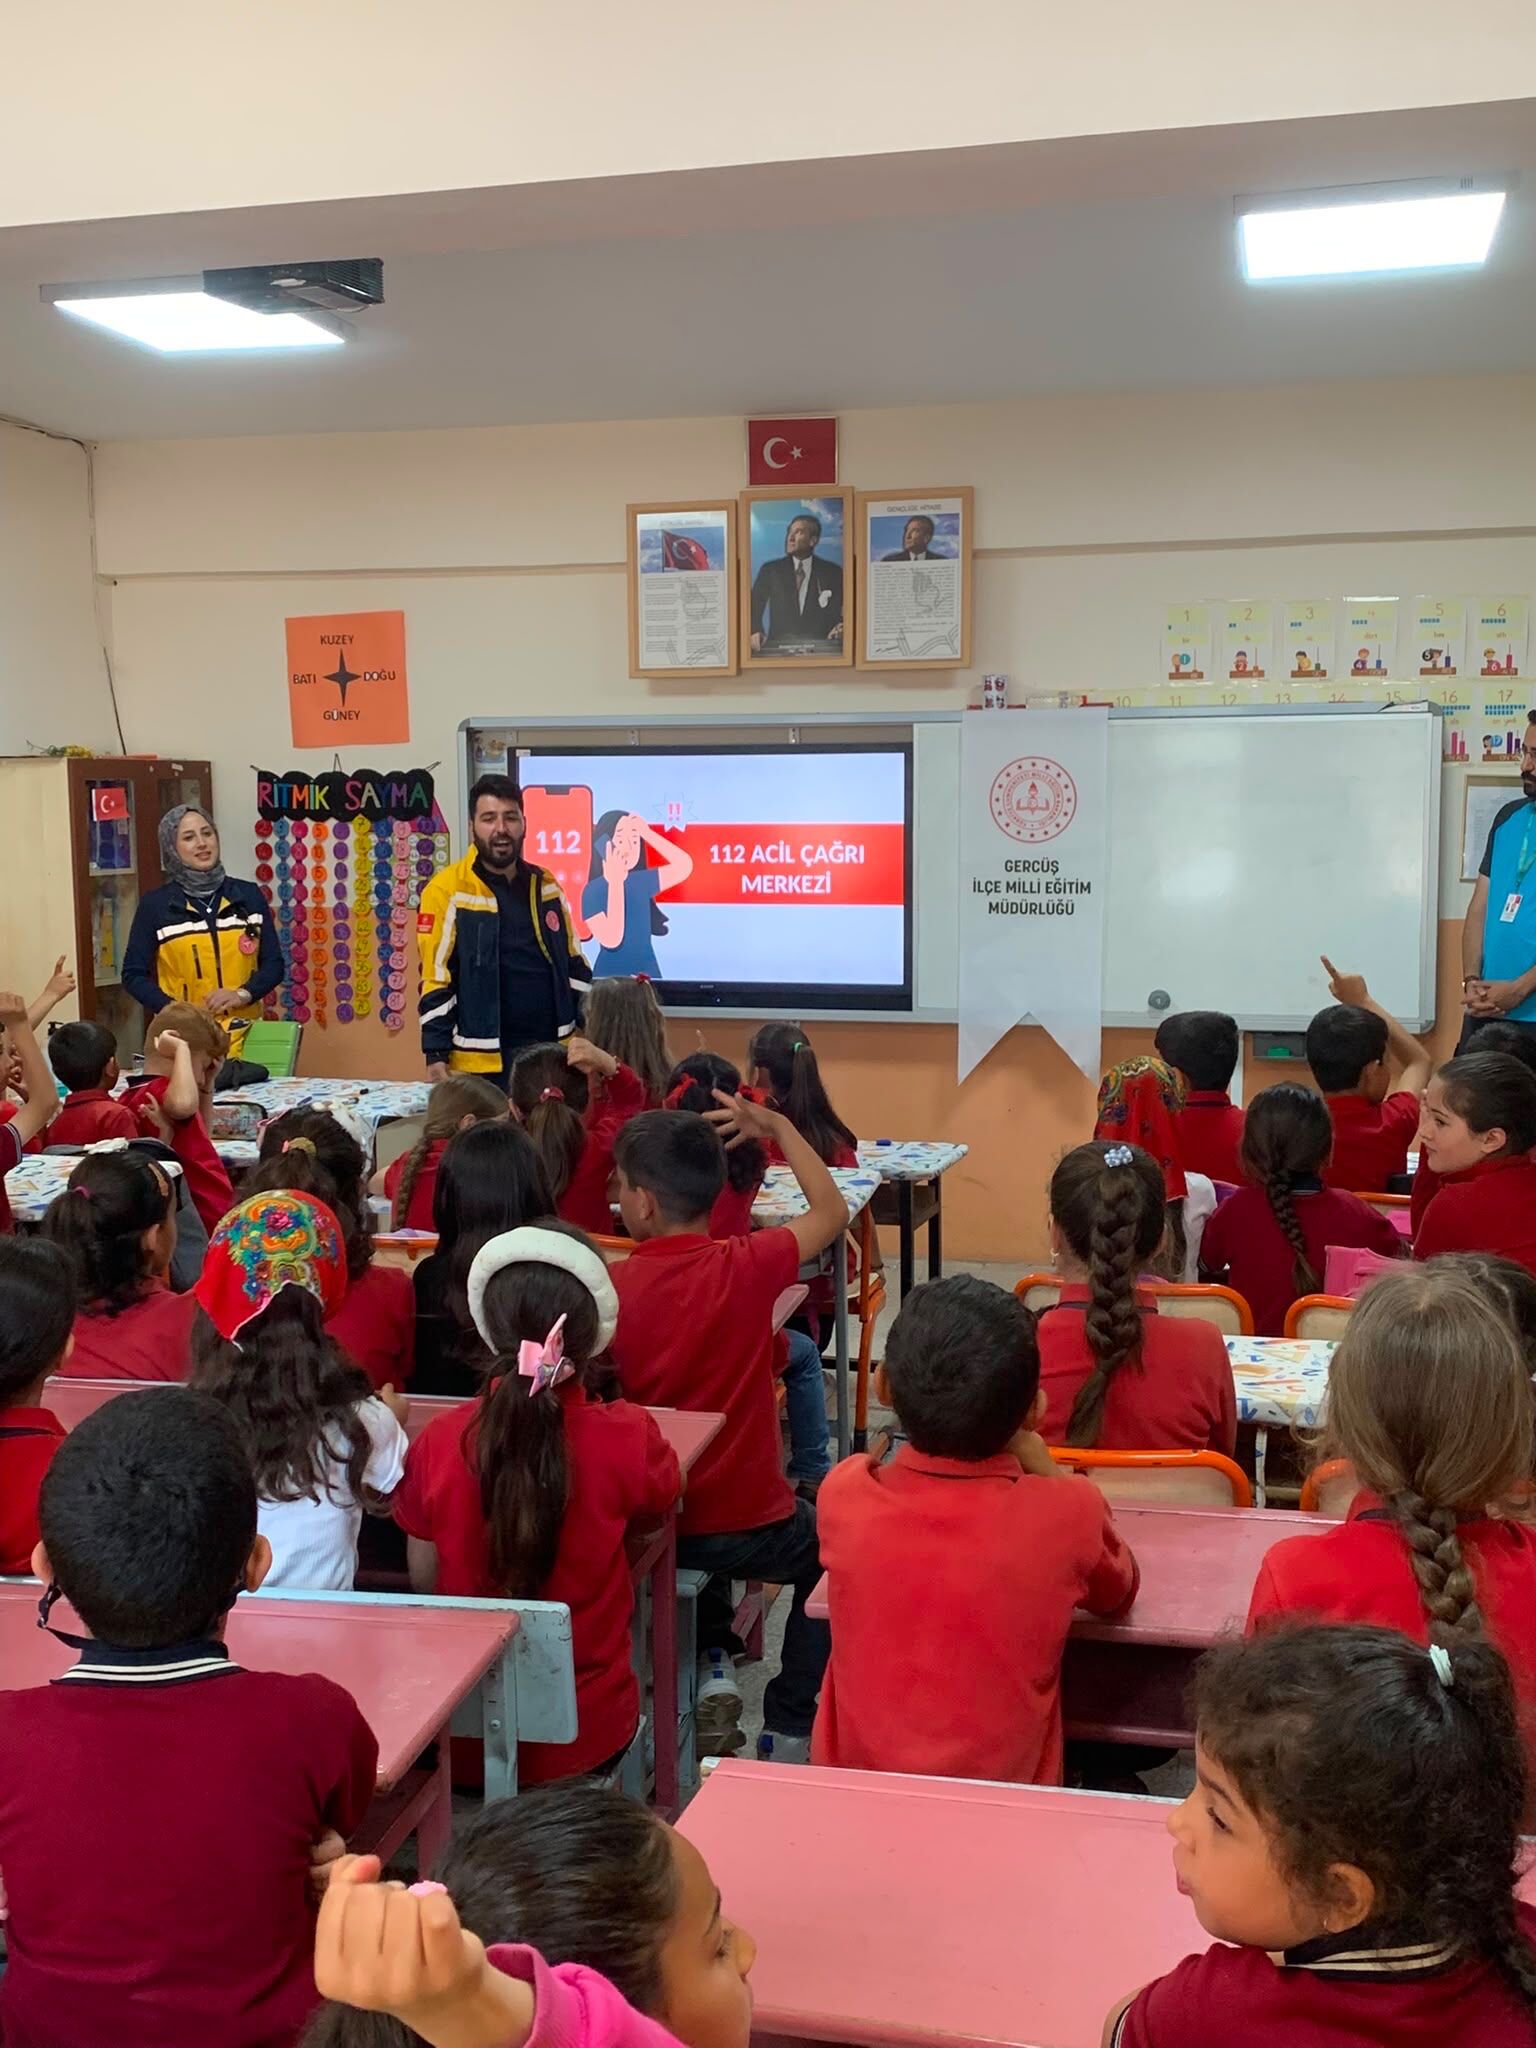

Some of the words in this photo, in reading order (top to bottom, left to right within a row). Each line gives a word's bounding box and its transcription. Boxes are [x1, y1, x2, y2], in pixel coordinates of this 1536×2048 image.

[1184, 609, 1190, 622] 1
[1244, 607, 1253, 621] 2
[1305, 606, 1314, 620] 3
[1435, 602, 1444, 616] 5
[1497, 602, 1506, 616] 6
[320, 634, 354, 646] KUZEY
[293, 674, 317, 684] BATI
[363, 668, 397, 682] DOĞU
[1116, 695, 1132, 708] 10
[1170, 695, 1182, 707] 11
[1221, 693, 1237, 706] 12
[1275, 693, 1291, 704] 13
[1442, 690, 1458, 703] 16
[1499, 689, 1513, 702] 17
[323, 709, 361, 721] GÜNEY
[258, 779, 331, 810] RİTMİK
[345, 781, 428, 811] SAYMA
[357, 819, 367, 832] 7
[536, 831, 581, 854] 112
[709, 844, 745, 864] 112
[750, 840, 796, 864] ACİL
[800, 839, 865, 869] ÇAĞRI
[1004, 857, 1059, 877] GERCÜŞ
[741, 870, 832, 894] MERKEZİ
[972, 876, 1001, 896] İLÇE
[1005, 877, 1041, 894] MİLLİ
[1045, 876, 1091, 894] EĞİTİM
[988, 898, 1075, 916] MÜDÜRLÜĞÜ
[388, 1015, 401, 1027] 90
